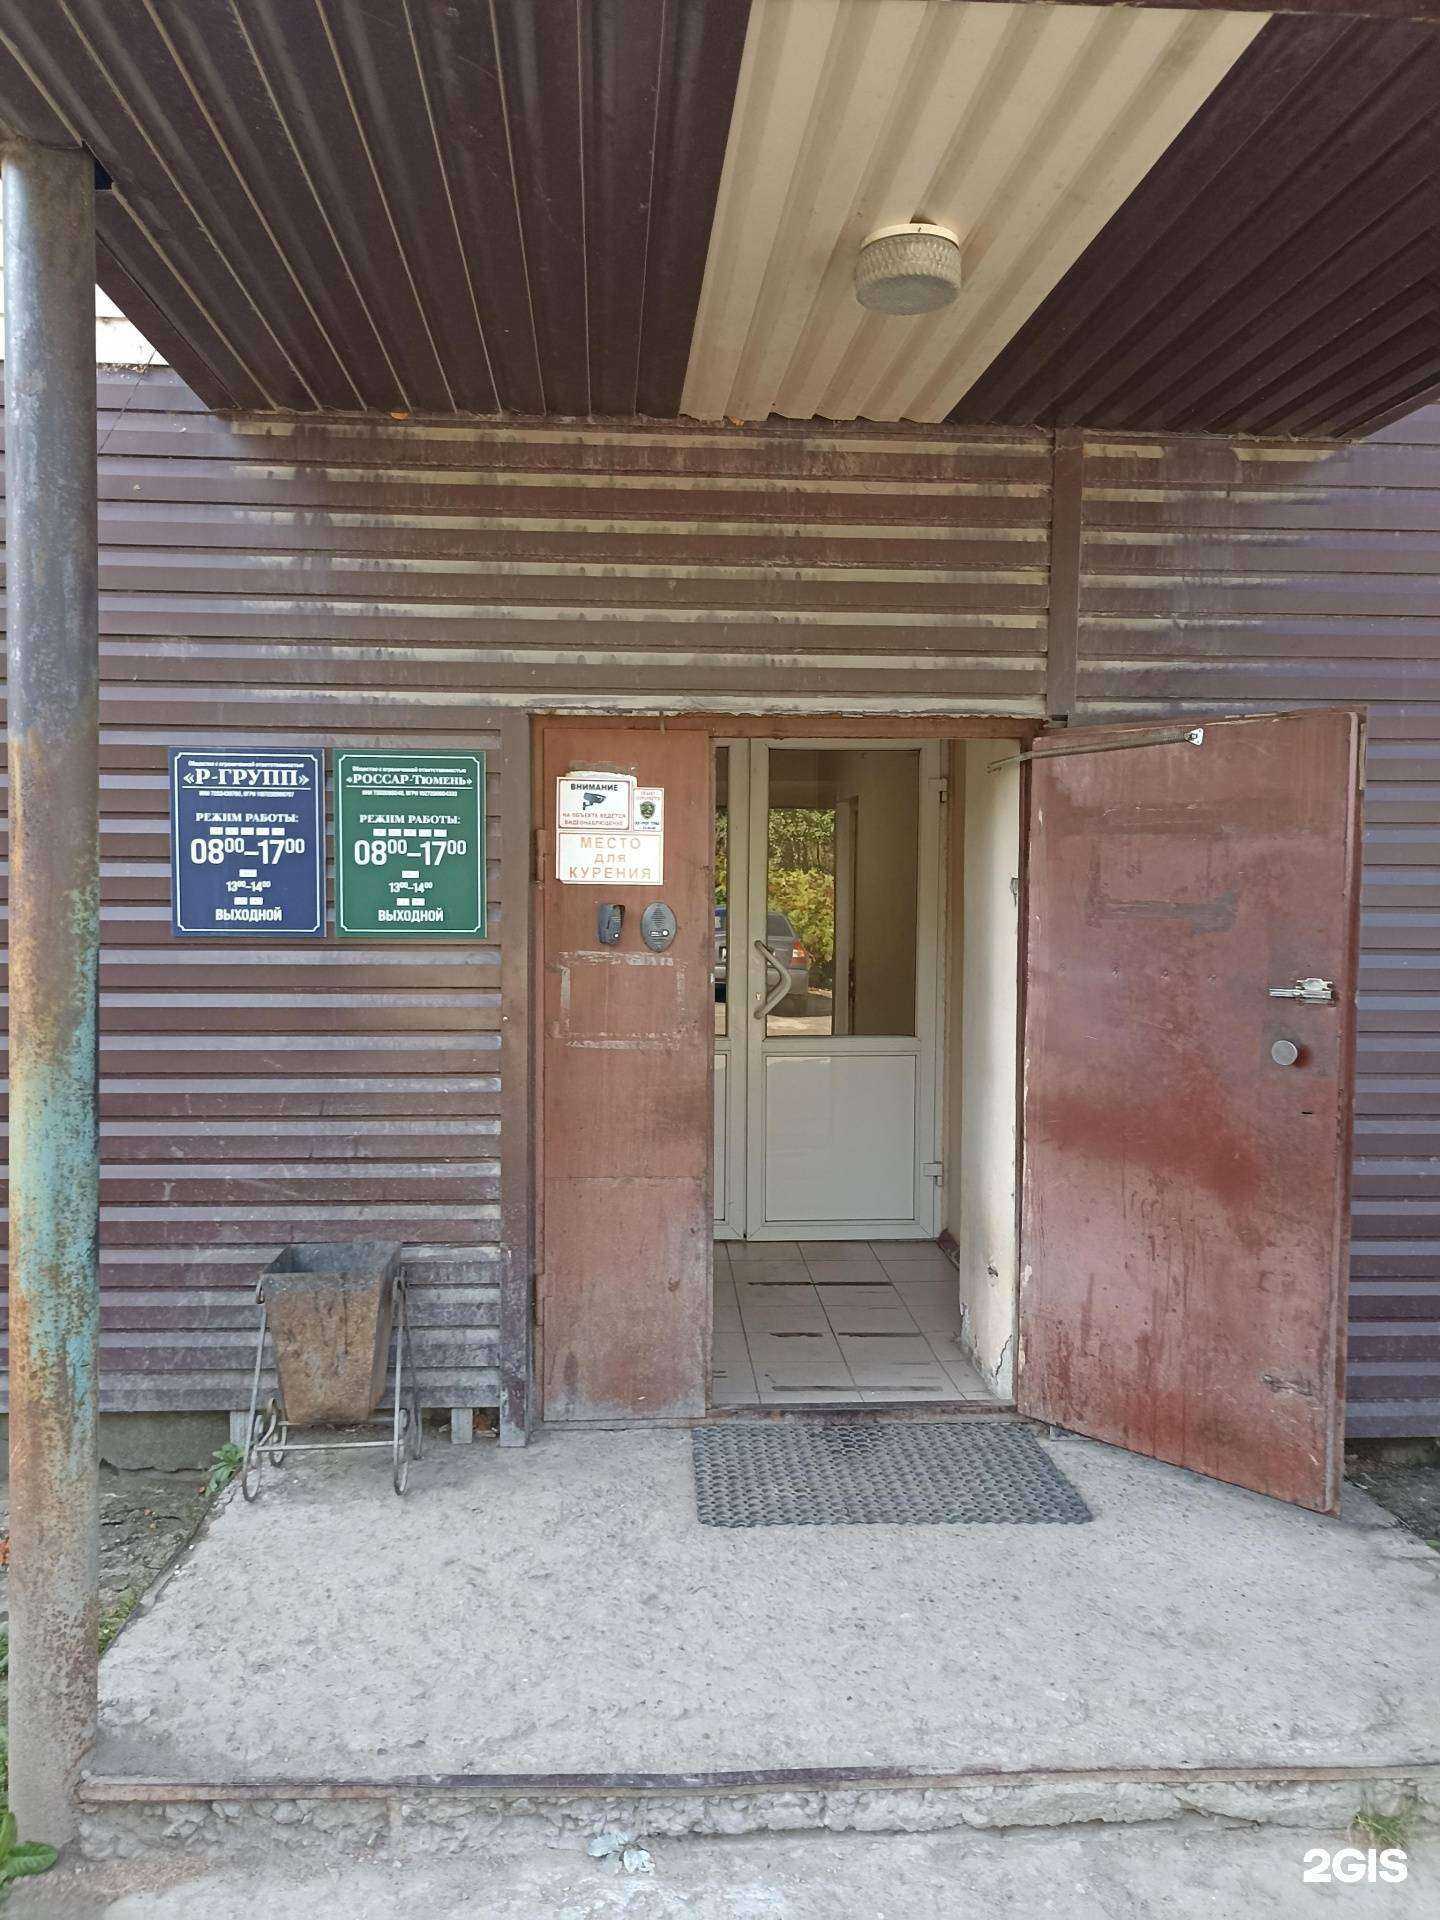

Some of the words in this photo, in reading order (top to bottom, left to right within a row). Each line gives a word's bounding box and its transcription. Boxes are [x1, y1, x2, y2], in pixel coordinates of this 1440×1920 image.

[183, 768, 310, 786] «Р-ГРУПП»
[570, 783, 619, 791] ВНИМАНИЕ
[195, 812, 242, 822] РЕЖИМ
[245, 813, 299, 823] РАБОТЫ:
[359, 814, 405, 824] РЕЖИМ
[408, 815, 461, 824] РАБОТЫ:
[580, 836, 641, 849] МЕСТО
[569, 866, 651, 880] КУРЕНИЯ
[215, 906, 283, 922] ВЫХОДНОЙ
[377, 907, 444, 922] ВЫХОДНОЙ
